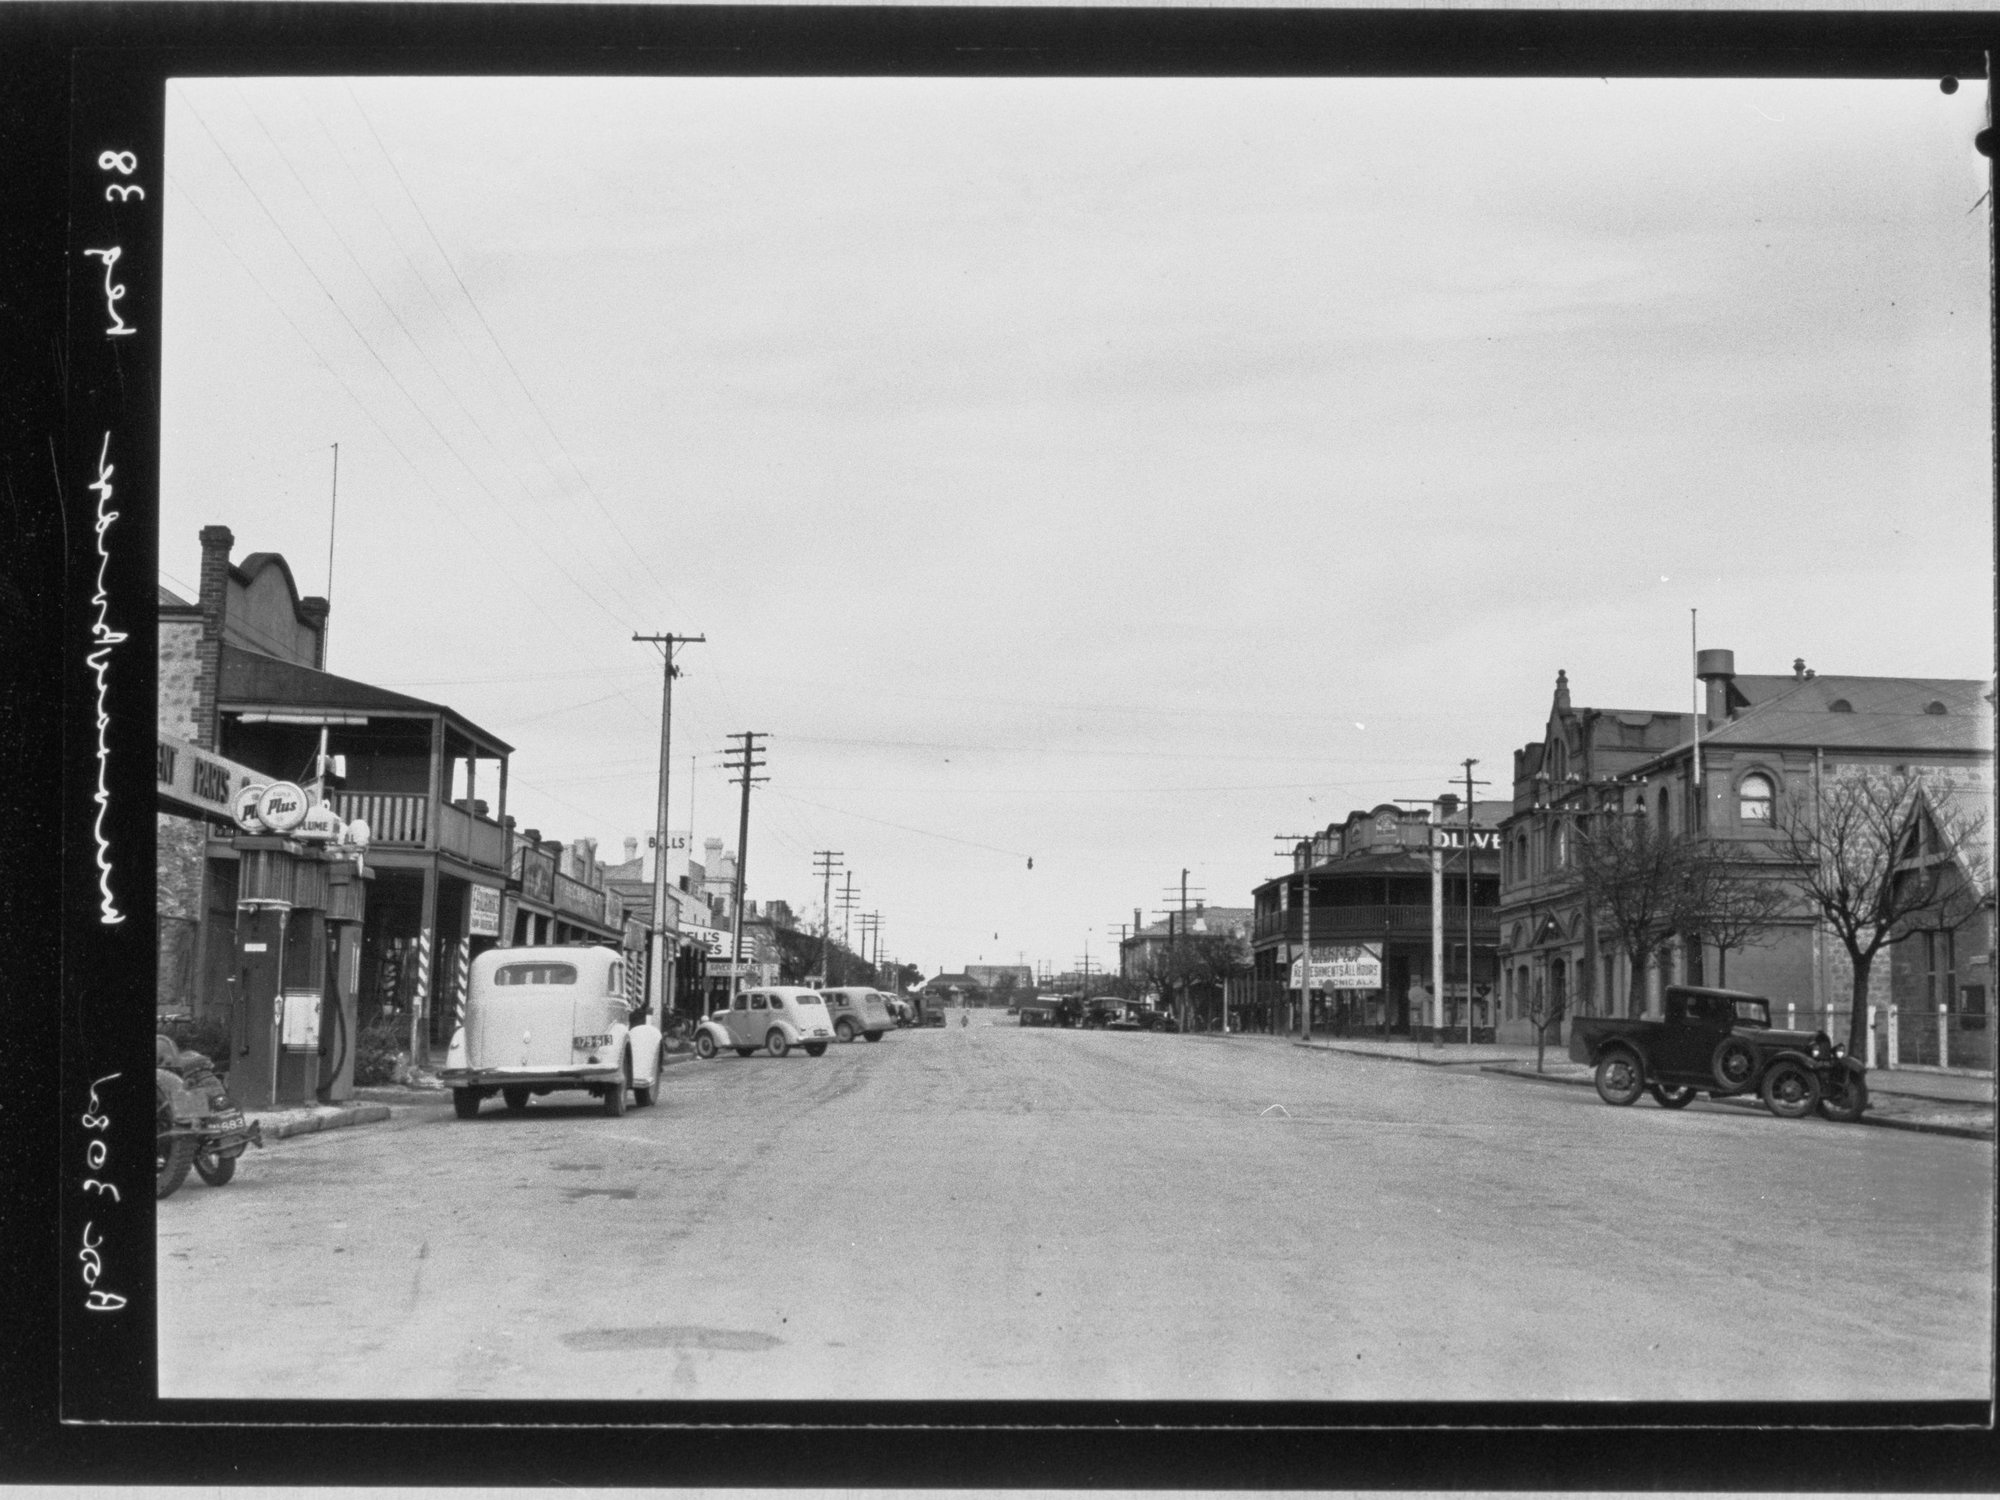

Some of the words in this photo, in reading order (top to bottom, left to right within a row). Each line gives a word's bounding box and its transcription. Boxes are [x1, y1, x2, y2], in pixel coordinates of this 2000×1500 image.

[193, 757, 231, 804] PARTS
[241, 803, 259, 822] Pl
[266, 797, 297, 816] Plus
[648, 837, 685, 849] BLS
[1441, 832, 1501, 849] OLVE
[679, 931, 720, 943] ELL'S
